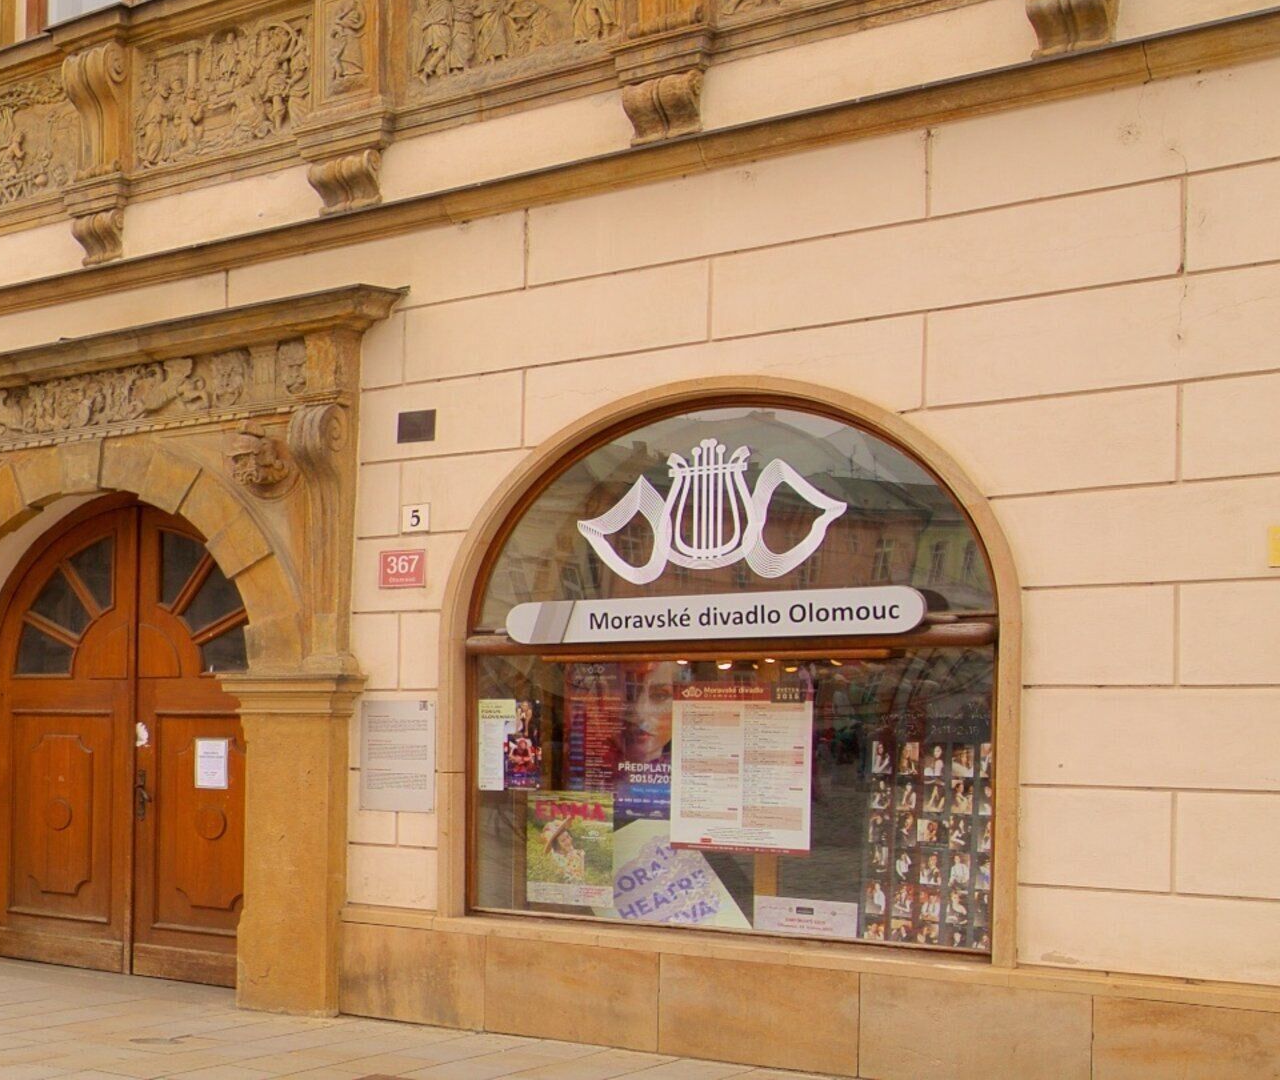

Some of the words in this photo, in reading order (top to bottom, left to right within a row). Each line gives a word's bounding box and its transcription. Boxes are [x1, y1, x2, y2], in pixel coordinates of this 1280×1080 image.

[410, 509, 421, 527] 5
[386, 555, 419, 574] 367
[589, 608, 690, 630] Moravské
[698, 604, 781, 627] divadlo
[789, 602, 900, 623] Olomouc
[535, 800, 606, 821] EMMA
